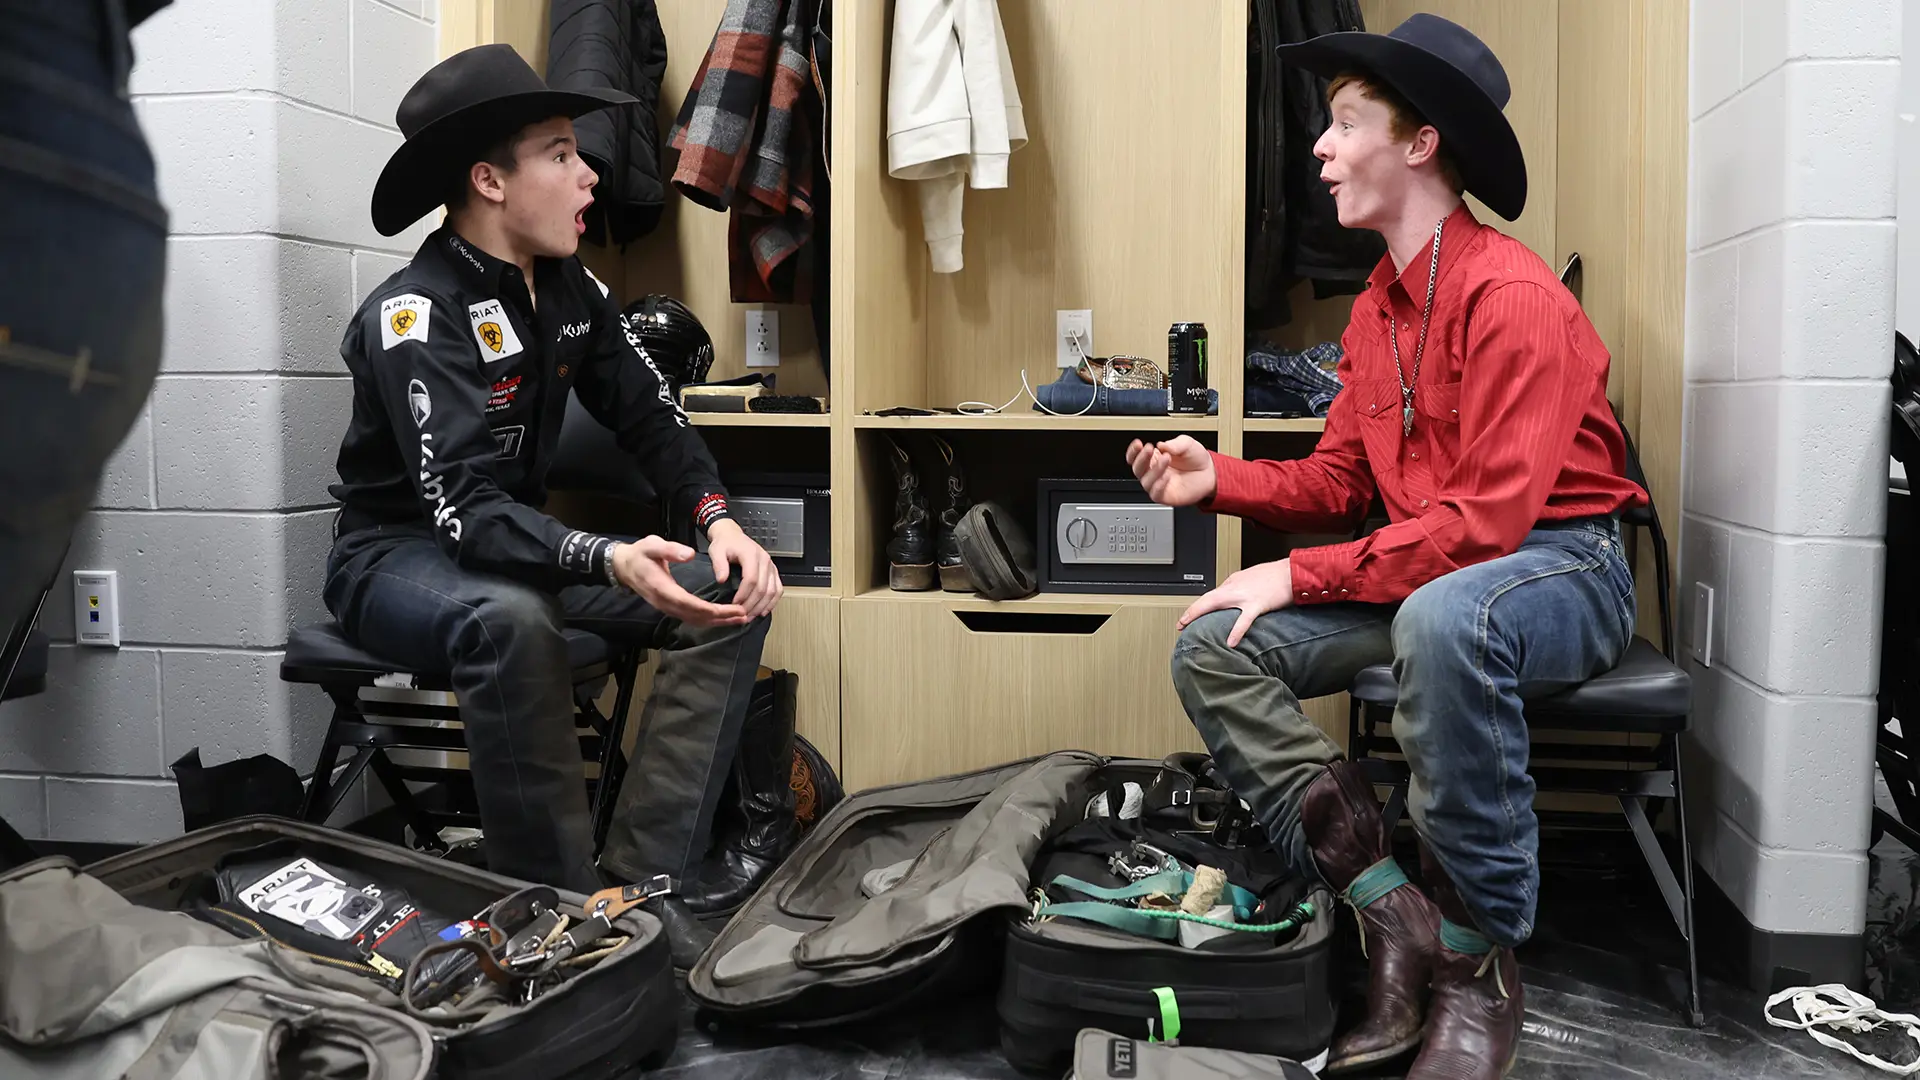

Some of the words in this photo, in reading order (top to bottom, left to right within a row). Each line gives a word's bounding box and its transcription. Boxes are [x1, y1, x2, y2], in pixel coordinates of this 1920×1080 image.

[460, 246, 484, 273] Kubota
[383, 298, 429, 312] ARIAT
[1115, 1040, 1131, 1072] YETI
